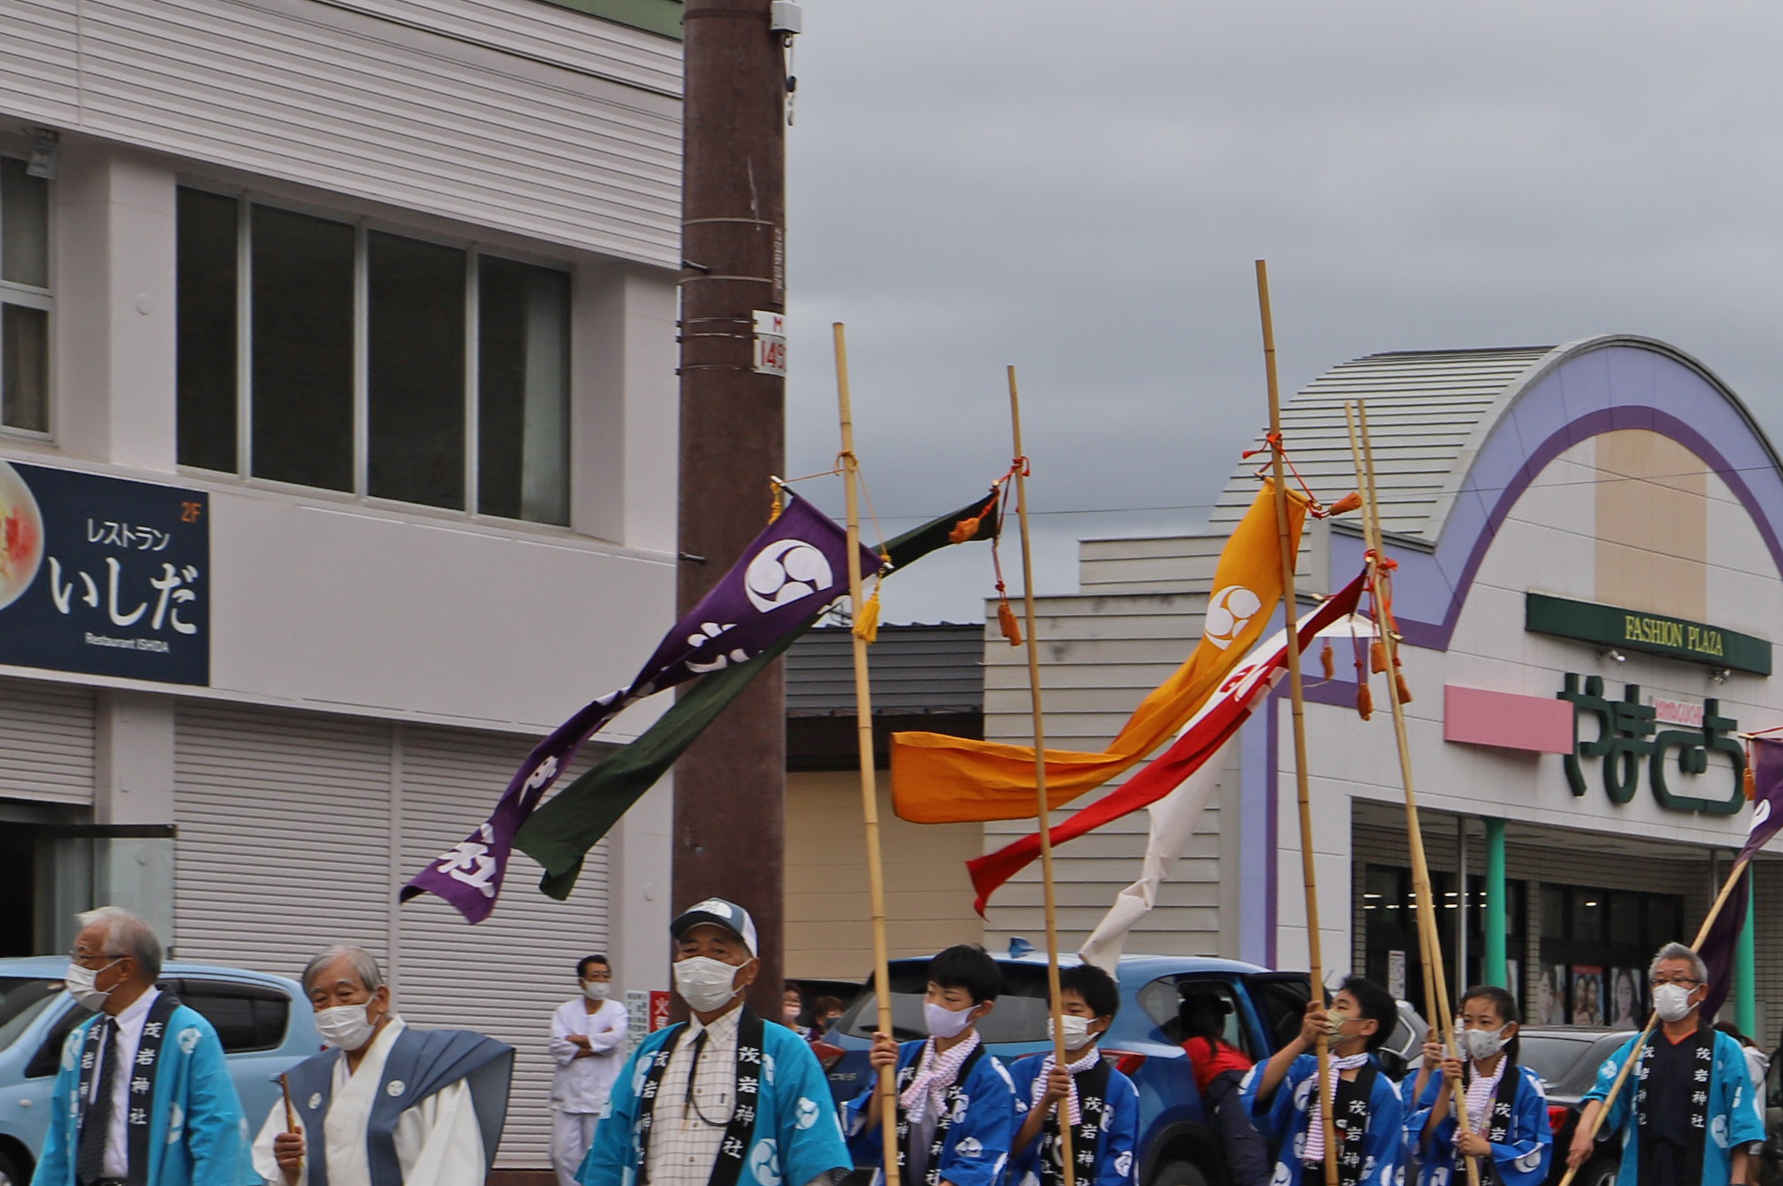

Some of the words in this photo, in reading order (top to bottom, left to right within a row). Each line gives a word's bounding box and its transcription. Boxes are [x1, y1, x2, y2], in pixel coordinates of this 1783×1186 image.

[87, 518, 170, 551] レストラン
[181, 502, 201, 522] 2F
[48, 556, 199, 635] いしだ
[85, 632, 135, 650] Restaurant
[136, 638, 170, 653] ISHIDA
[1624, 614, 1684, 649] FASHION
[1687, 625, 1724, 657] PLAZA
[1556, 672, 1746, 815] やまぐち
[128, 1022, 163, 1125] 茂岩神社
[722, 1046, 762, 1159] 茂岩神社
[1691, 1047, 1712, 1129] 茂岩神社
